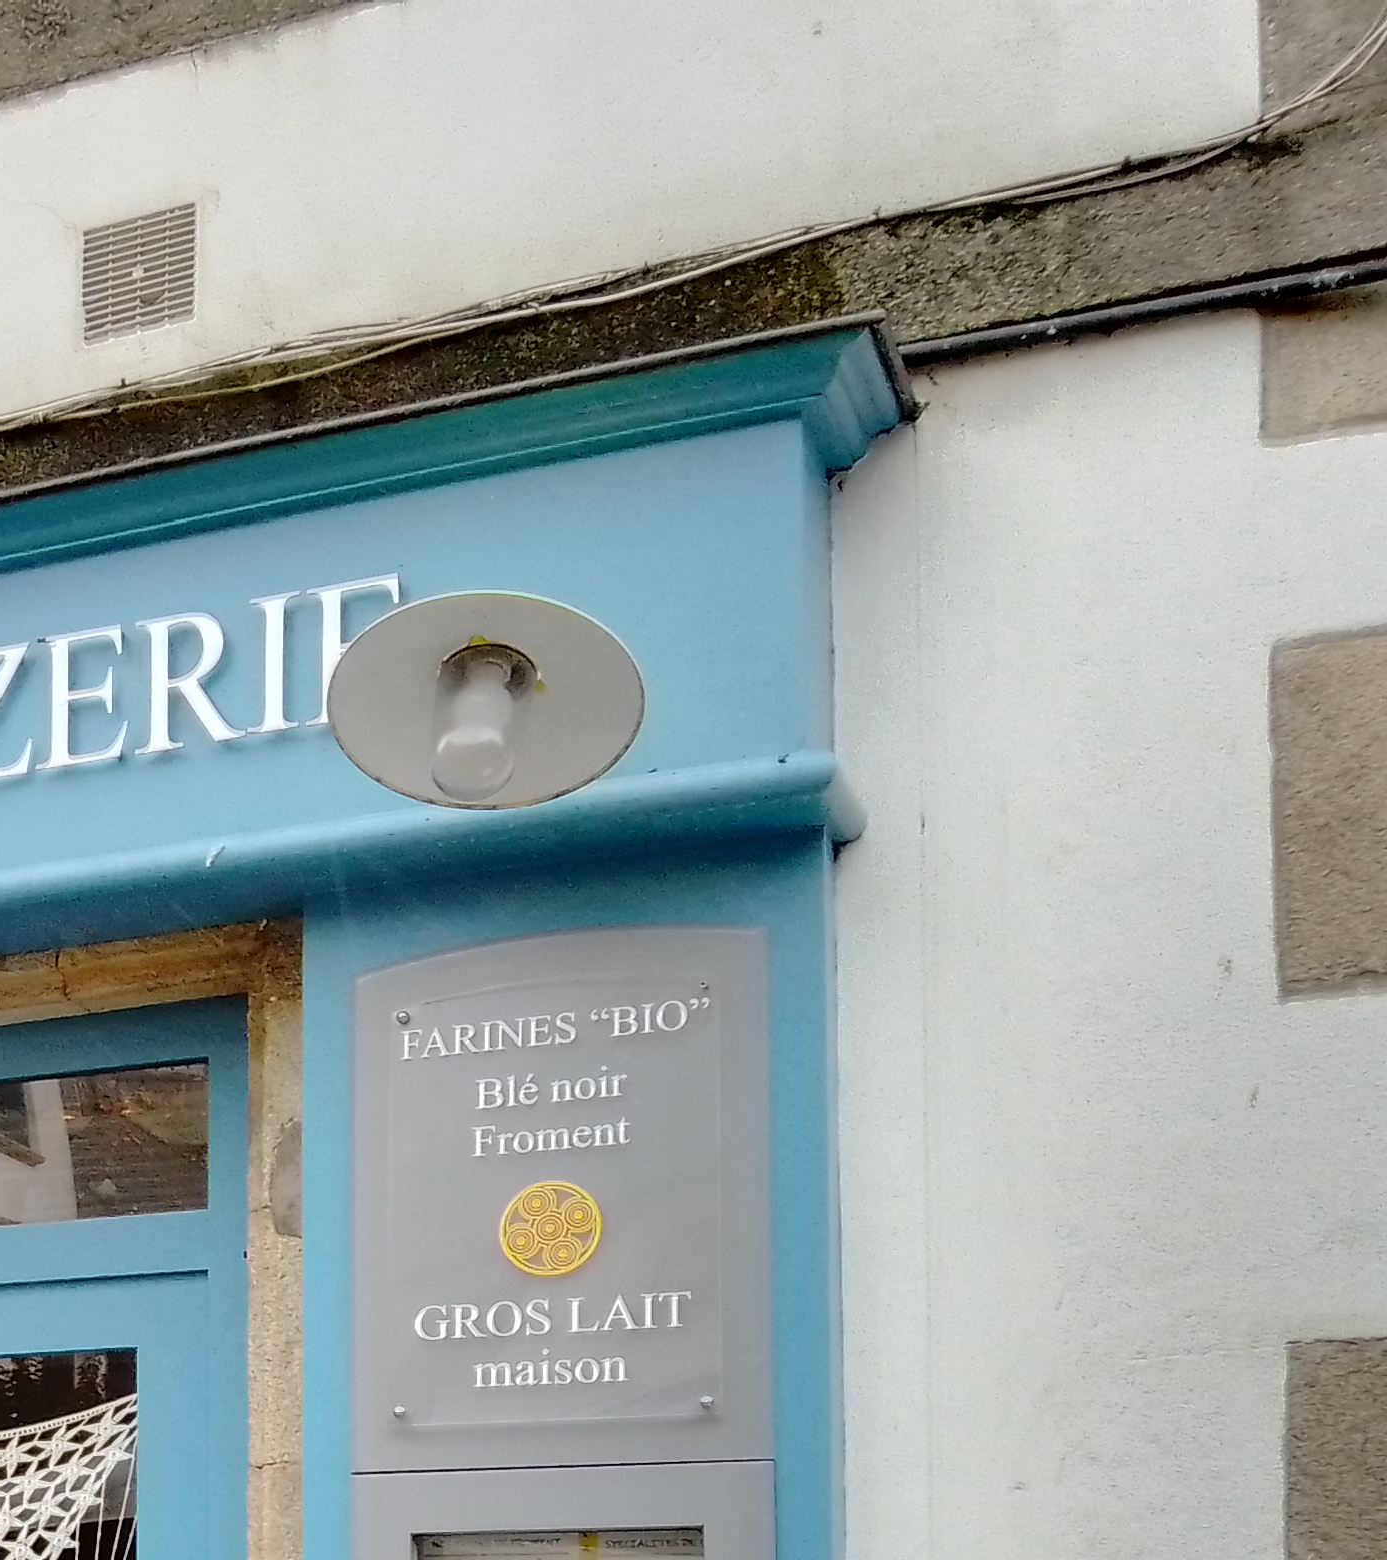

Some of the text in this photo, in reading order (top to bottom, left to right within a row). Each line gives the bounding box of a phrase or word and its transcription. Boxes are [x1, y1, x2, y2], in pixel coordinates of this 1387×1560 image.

[400, 1012, 578, 1061] FARINES
[474, 1065, 628, 1111] Blé noir
[471, 1116, 632, 1158] Froment
[413, 1289, 693, 1343] GROS LAIT
[473, 1348, 629, 1389] maison
